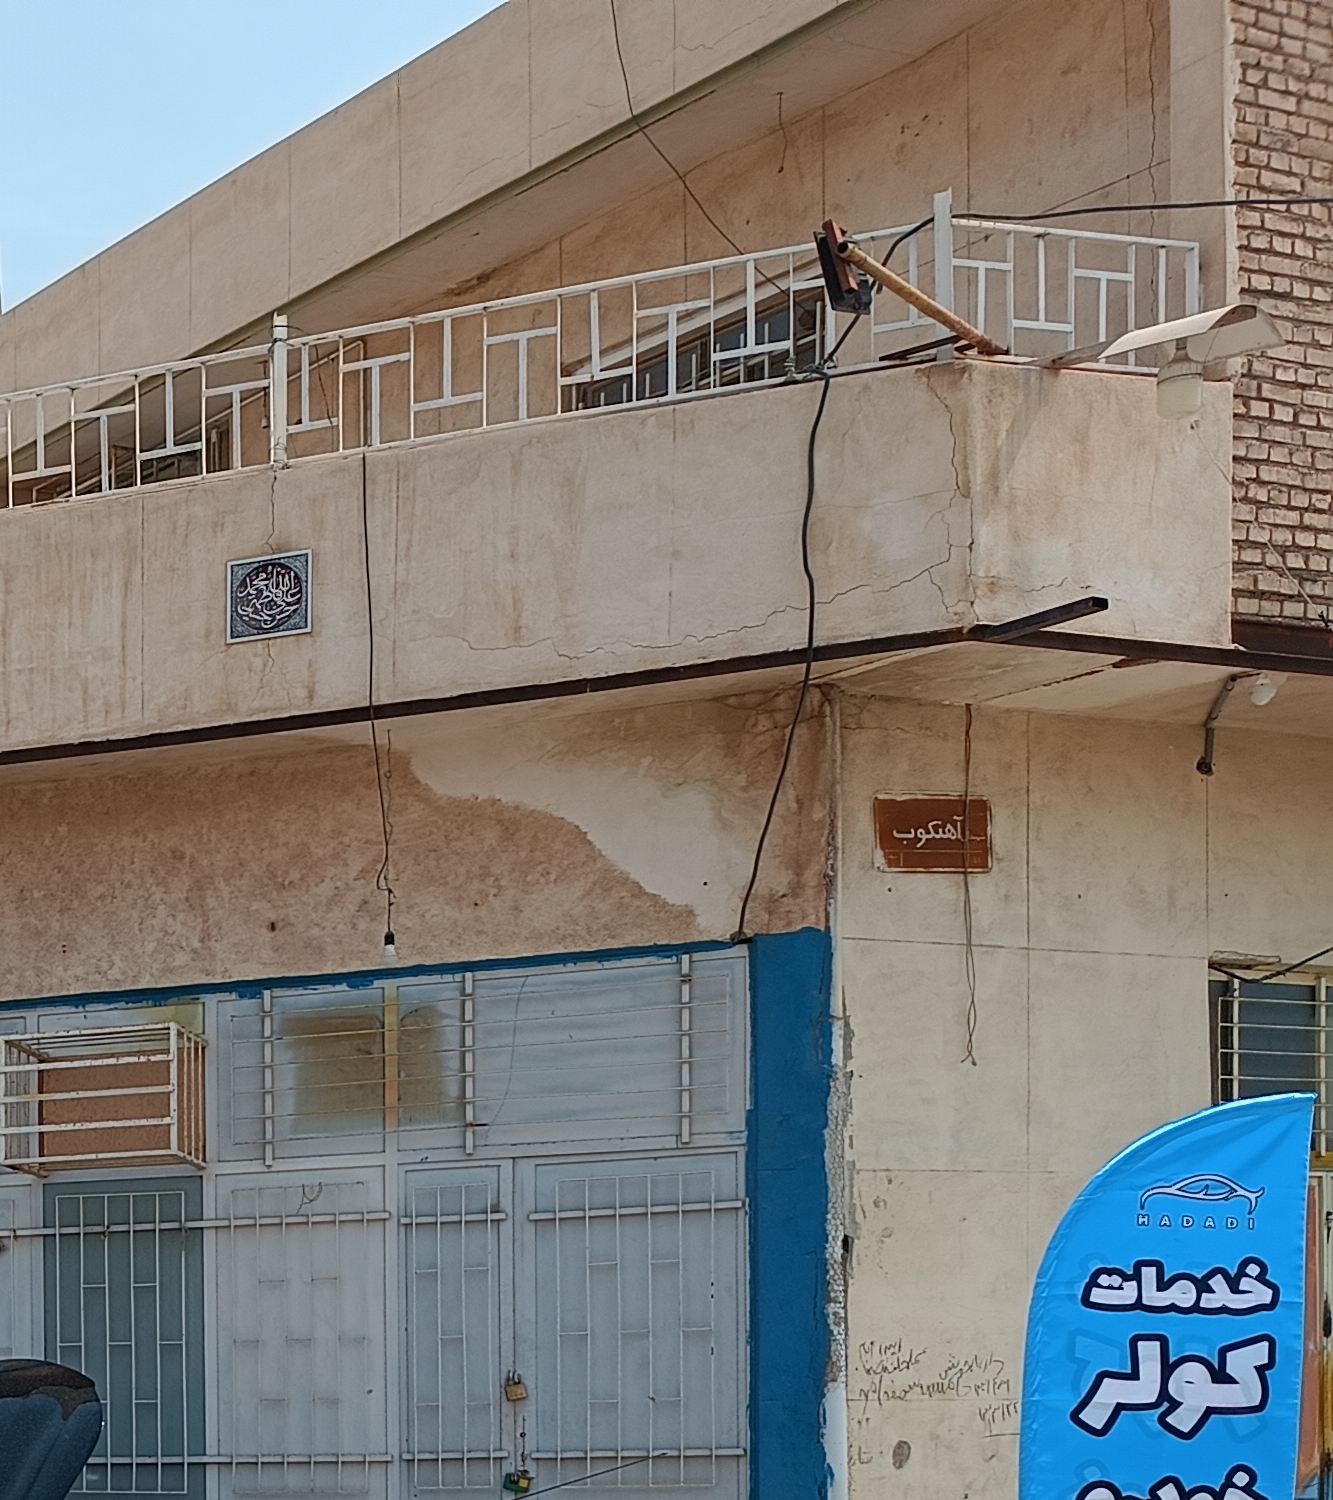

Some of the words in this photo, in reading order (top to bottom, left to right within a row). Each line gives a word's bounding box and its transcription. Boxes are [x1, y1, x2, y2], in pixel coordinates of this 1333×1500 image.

[1137, 1214, 1256, 1231] HADADI
[1082, 1257, 1278, 1315] خدمات
[1071, 1335, 1276, 1440] کولر
